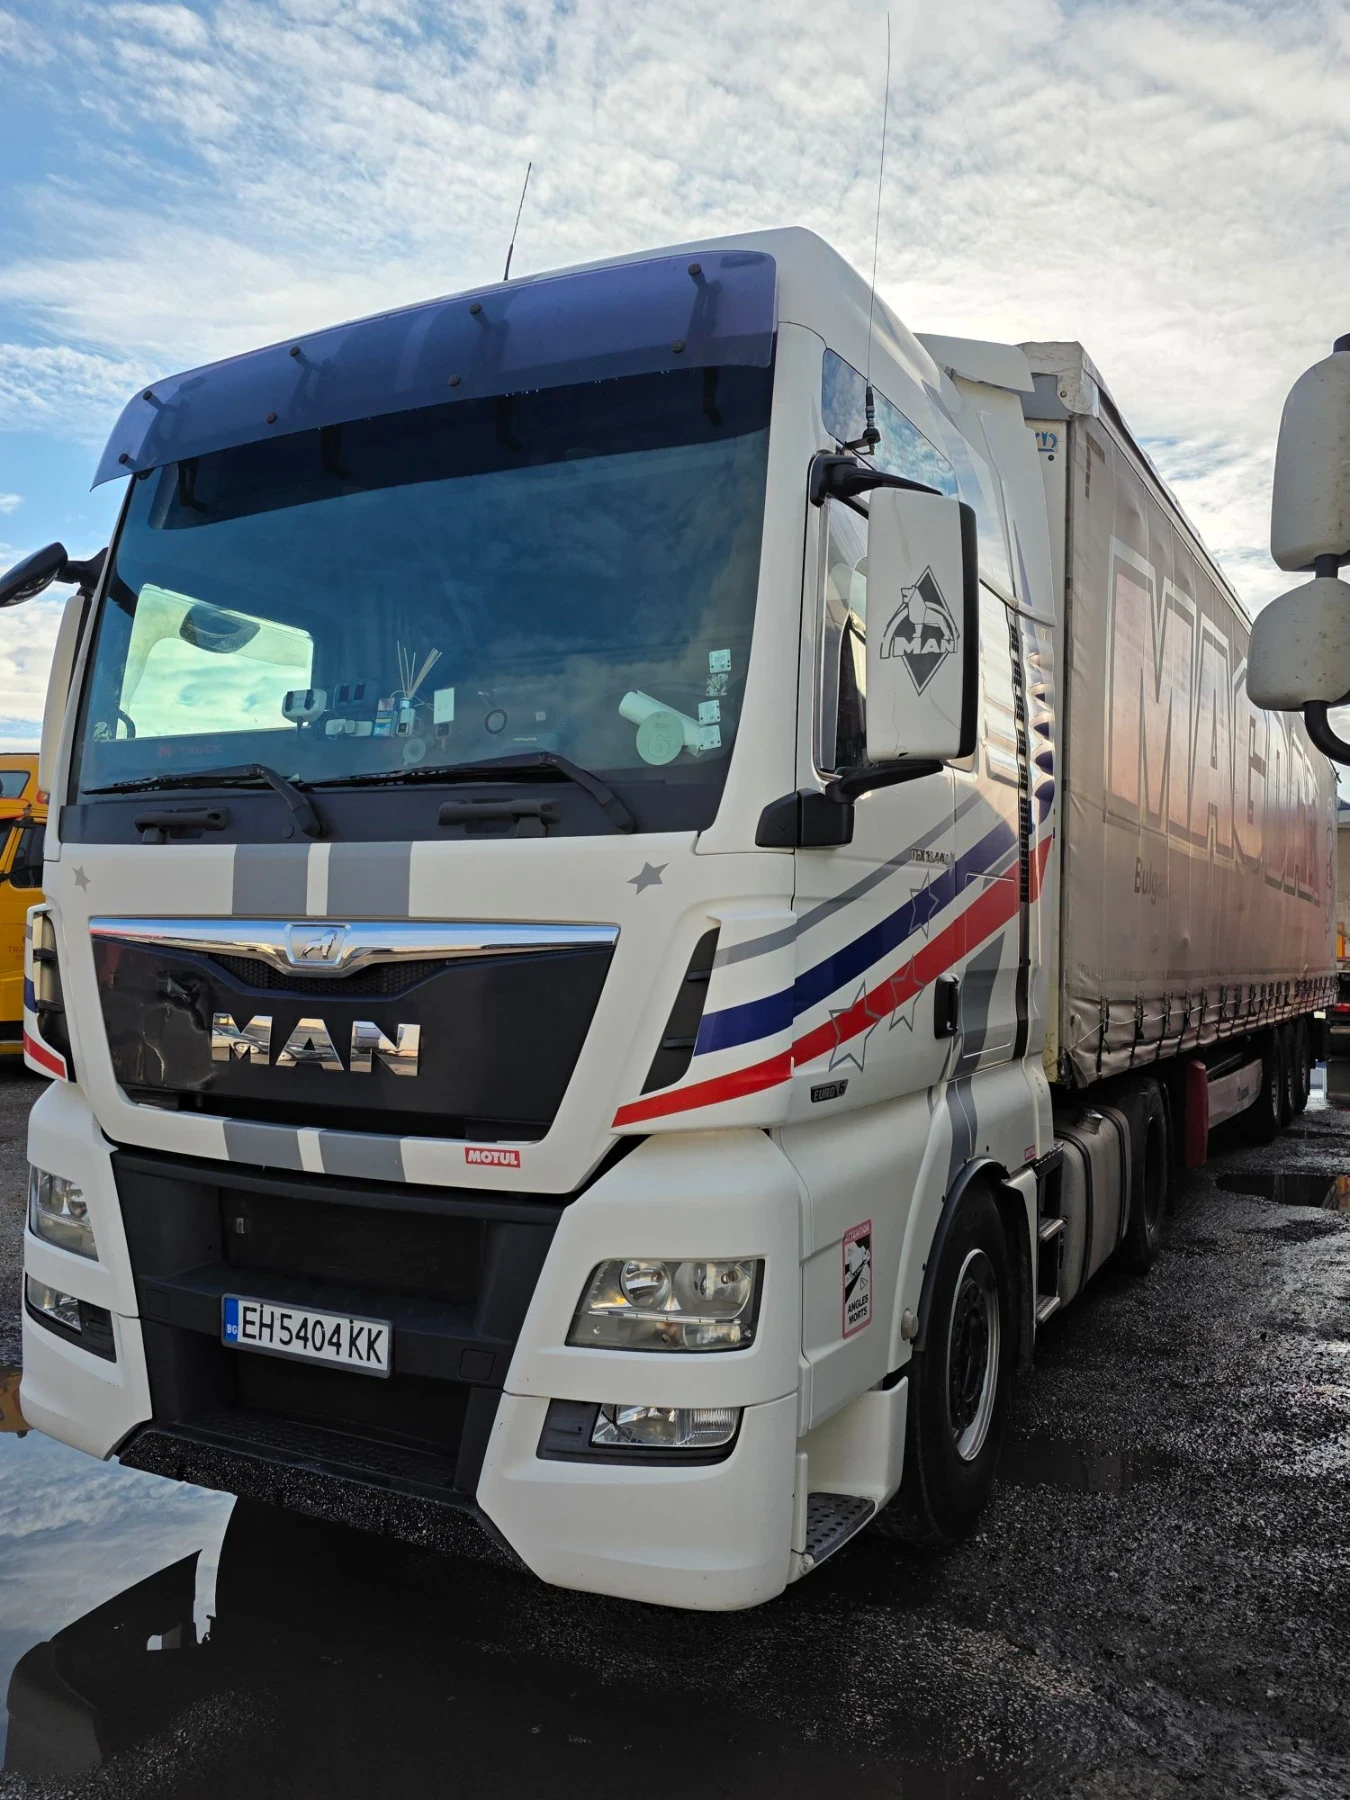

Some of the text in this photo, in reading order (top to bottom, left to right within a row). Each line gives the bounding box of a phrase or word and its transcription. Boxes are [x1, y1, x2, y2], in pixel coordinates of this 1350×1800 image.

[893, 636, 955, 657] MAN
[211, 1012, 421, 1076] MAN
[813, 1086, 836, 1101] EURO
[467, 1149, 518, 1165] MOTUL
[847, 1294, 869, 1314] ANGLES
[848, 1307, 868, 1325] MORTS
[226, 1323, 238, 1335] BG
